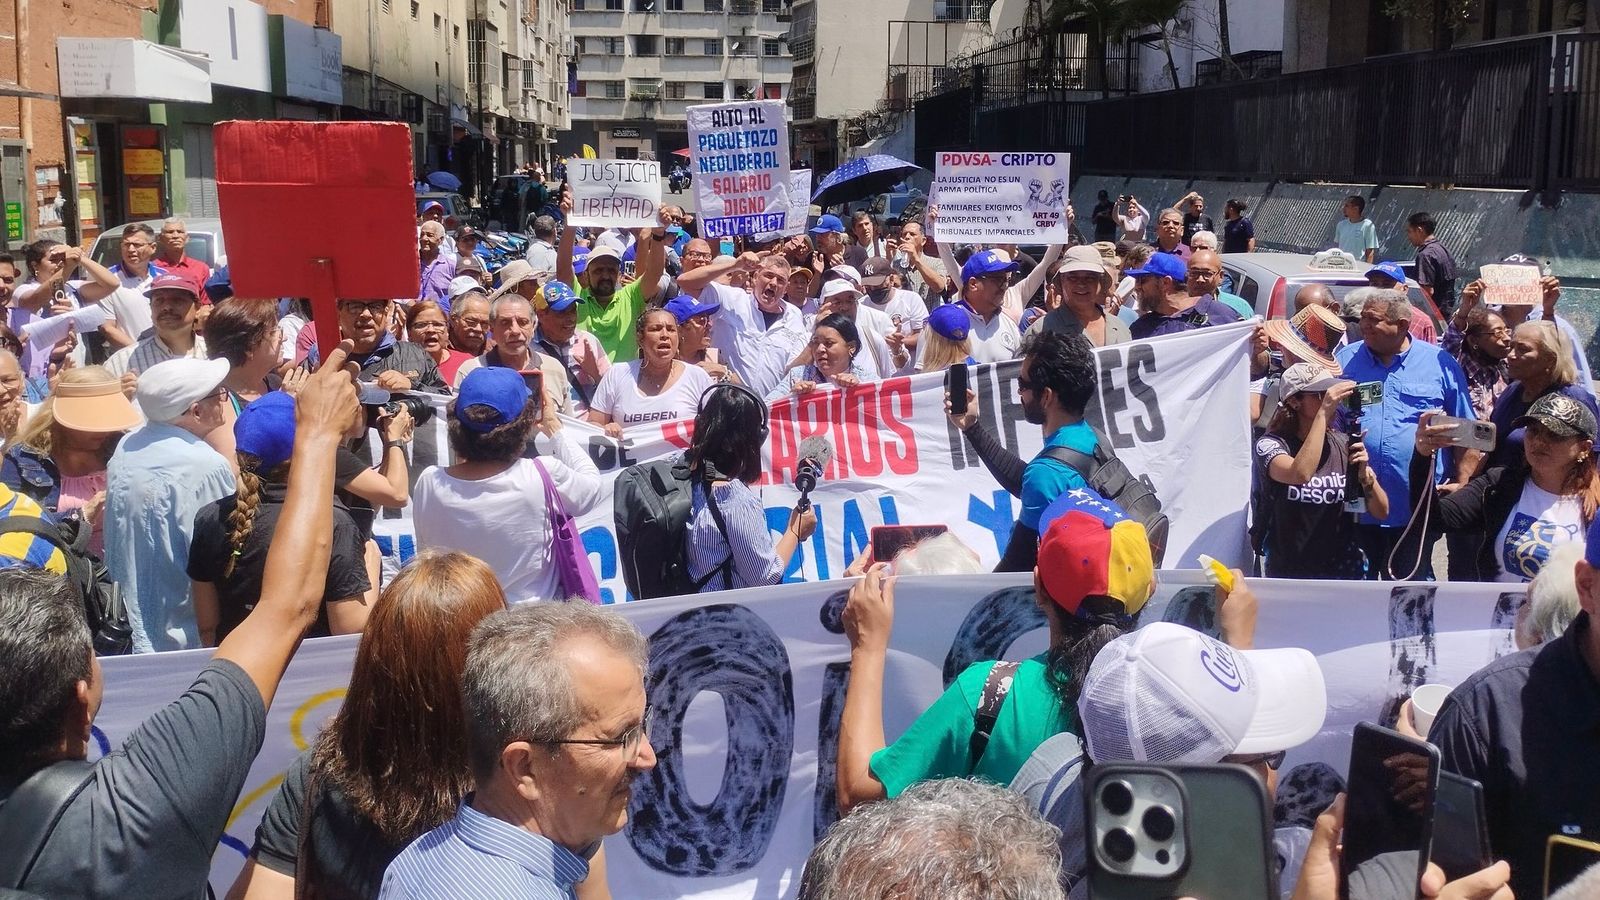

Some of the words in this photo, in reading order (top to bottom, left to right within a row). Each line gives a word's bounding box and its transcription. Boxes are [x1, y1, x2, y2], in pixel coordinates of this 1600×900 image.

[712, 108, 743, 128] ALTO
[748, 107, 765, 125] AL
[698, 128, 778, 152] PAQUETAZO
[699, 151, 780, 174] NEOLIBERAL
[1001, 153, 1056, 166] CRIPTO
[578, 162, 658, 183] JUSTICIA
[713, 174, 771, 196] SALARIO
[964, 185, 998, 193] POLÍTICA
[572, 197, 654, 219] LIBERTAD
[724, 196, 766, 216] DIGNO
[704, 213, 785, 238] CUTV-FNLCT
[937, 216, 999, 224] TRANSPARENCIA
[937, 228, 982, 236] TRIBUNALES
[985, 228, 1035, 236] IMPARCIALES
[623, 411, 678, 423] LIBEREN
[588, 435, 638, 471] DE
